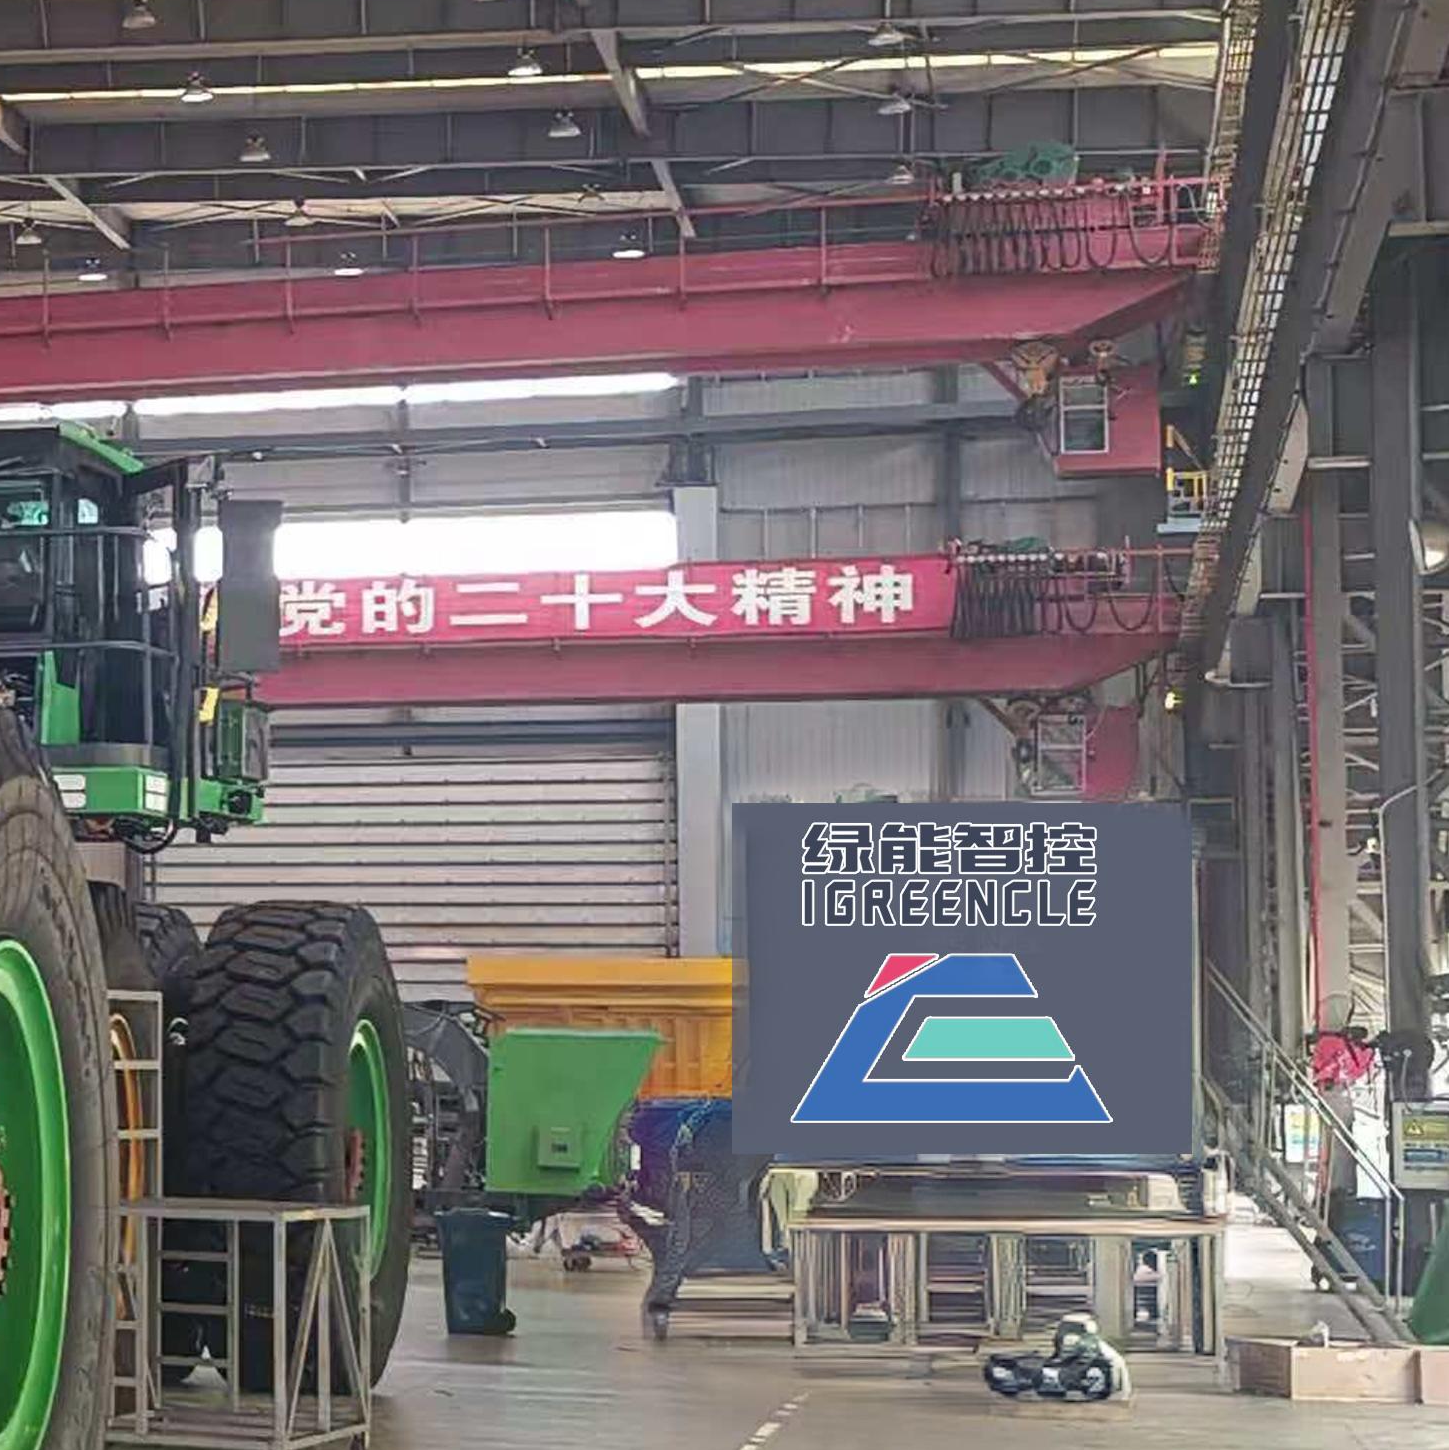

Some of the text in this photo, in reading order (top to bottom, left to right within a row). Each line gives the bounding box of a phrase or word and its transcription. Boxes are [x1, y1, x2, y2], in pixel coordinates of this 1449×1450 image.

[279, 564, 915, 637] 党的二十大精神
